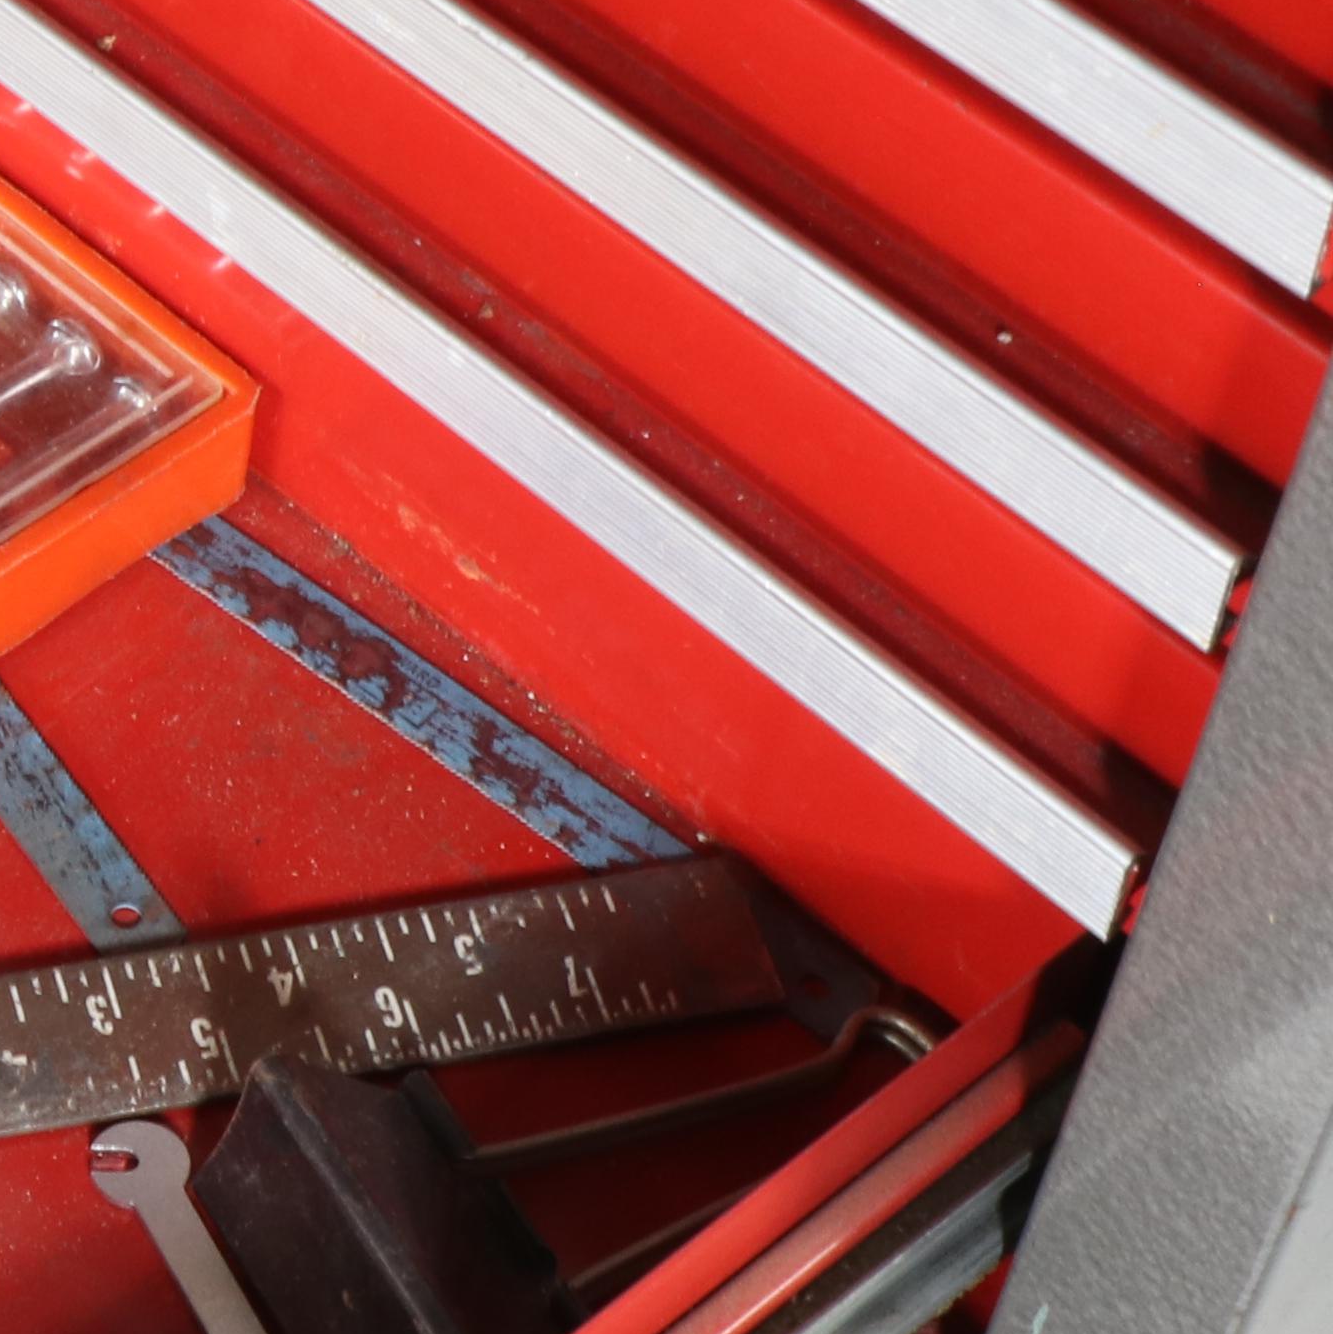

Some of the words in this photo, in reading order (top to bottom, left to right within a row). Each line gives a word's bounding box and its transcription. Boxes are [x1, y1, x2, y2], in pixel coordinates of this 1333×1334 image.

[453, 934, 483, 976] 5
[267, 966, 294, 1007] 4
[563, 955, 589, 998] 7
[86, 994, 114, 1036] 3
[374, 984, 404, 1029] 6
[189, 1017, 220, 1060] 5
